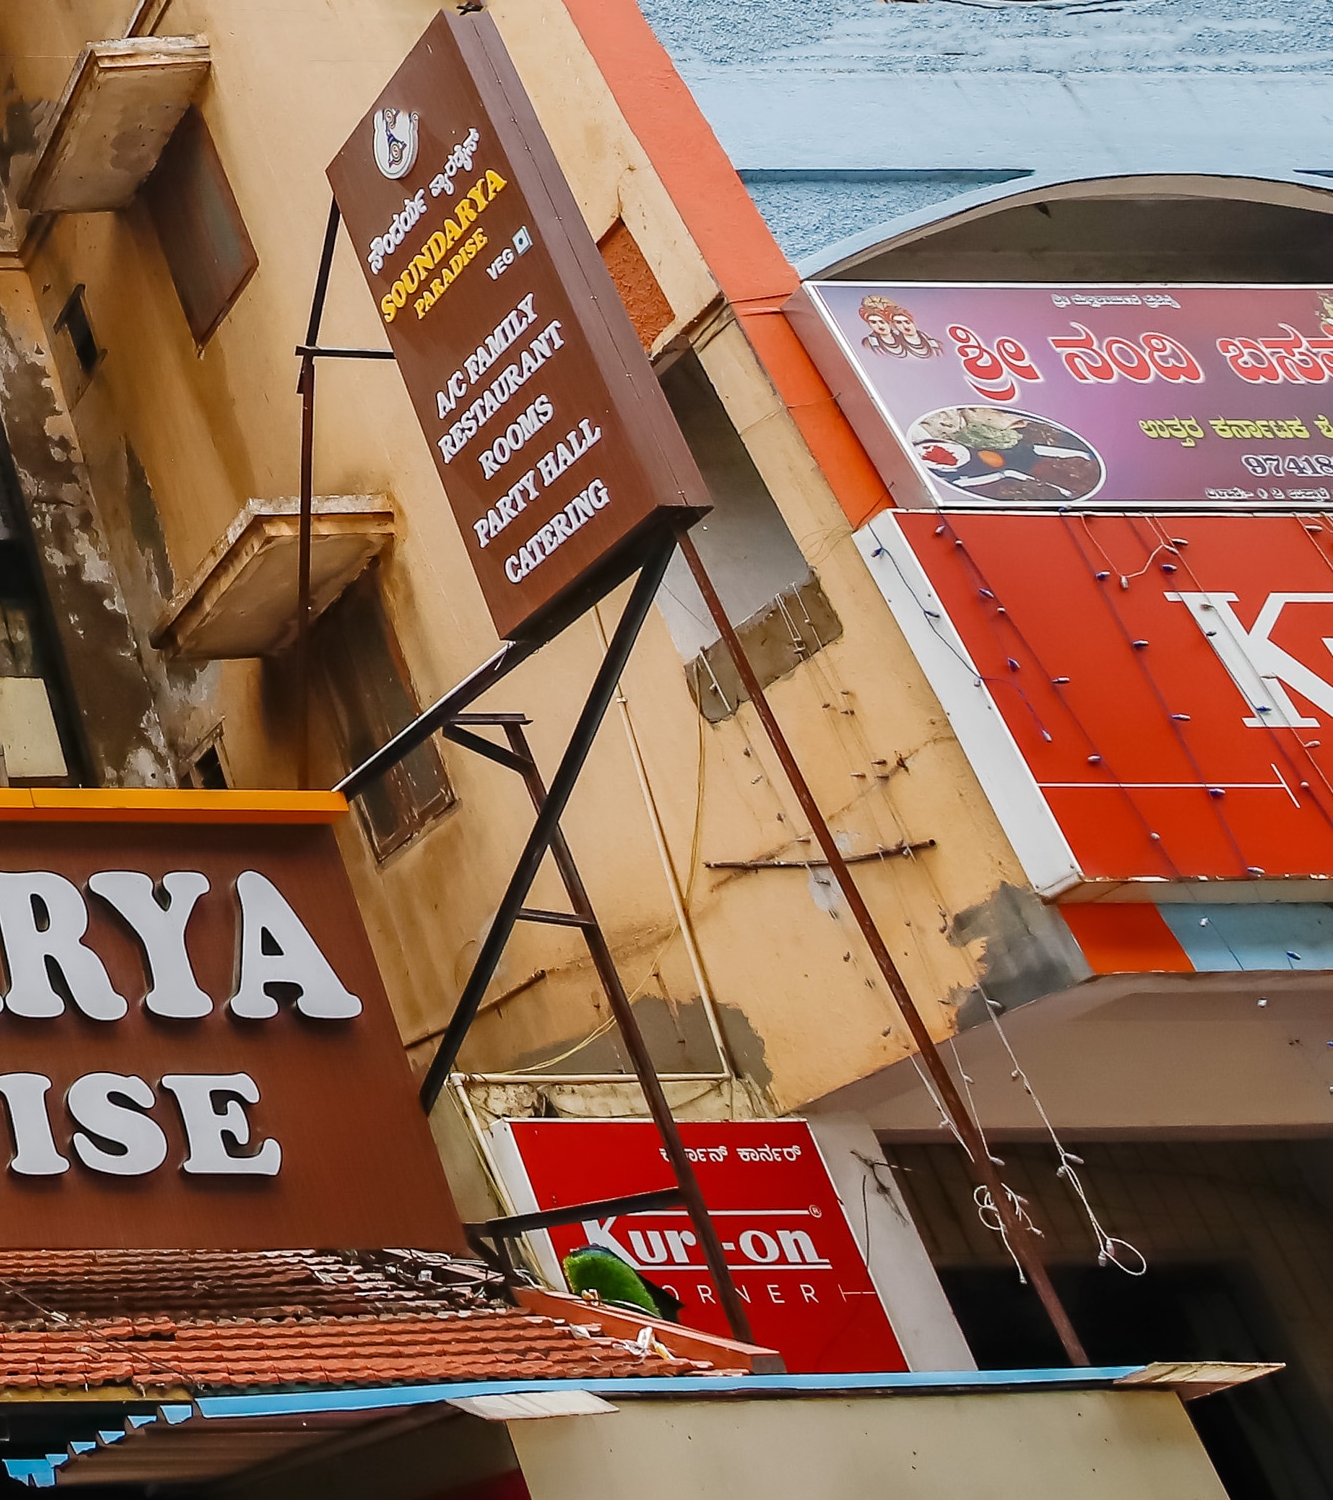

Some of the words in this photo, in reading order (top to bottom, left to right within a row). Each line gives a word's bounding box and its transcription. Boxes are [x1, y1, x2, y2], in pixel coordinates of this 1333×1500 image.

[380, 168, 508, 323] SOUNDARYA
[413, 227, 489, 319] PARADISE
[486, 248, 516, 281] VEG
[435, 370, 468, 420] A/C
[463, 292, 538, 385] FAMILY
[437, 319, 565, 465] RESTAURANT
[946, 322, 1045, 404] ಶ್ರೀ
[1048, 321, 1206, 384] ನಂದಿ
[473, 469, 540, 549] PARTY
[537, 417, 603, 487] HALL
[477, 394, 555, 481] ROOMS
[504, 478, 611, 584] CATERING
[581, 1216, 831, 1269] Kur-on
